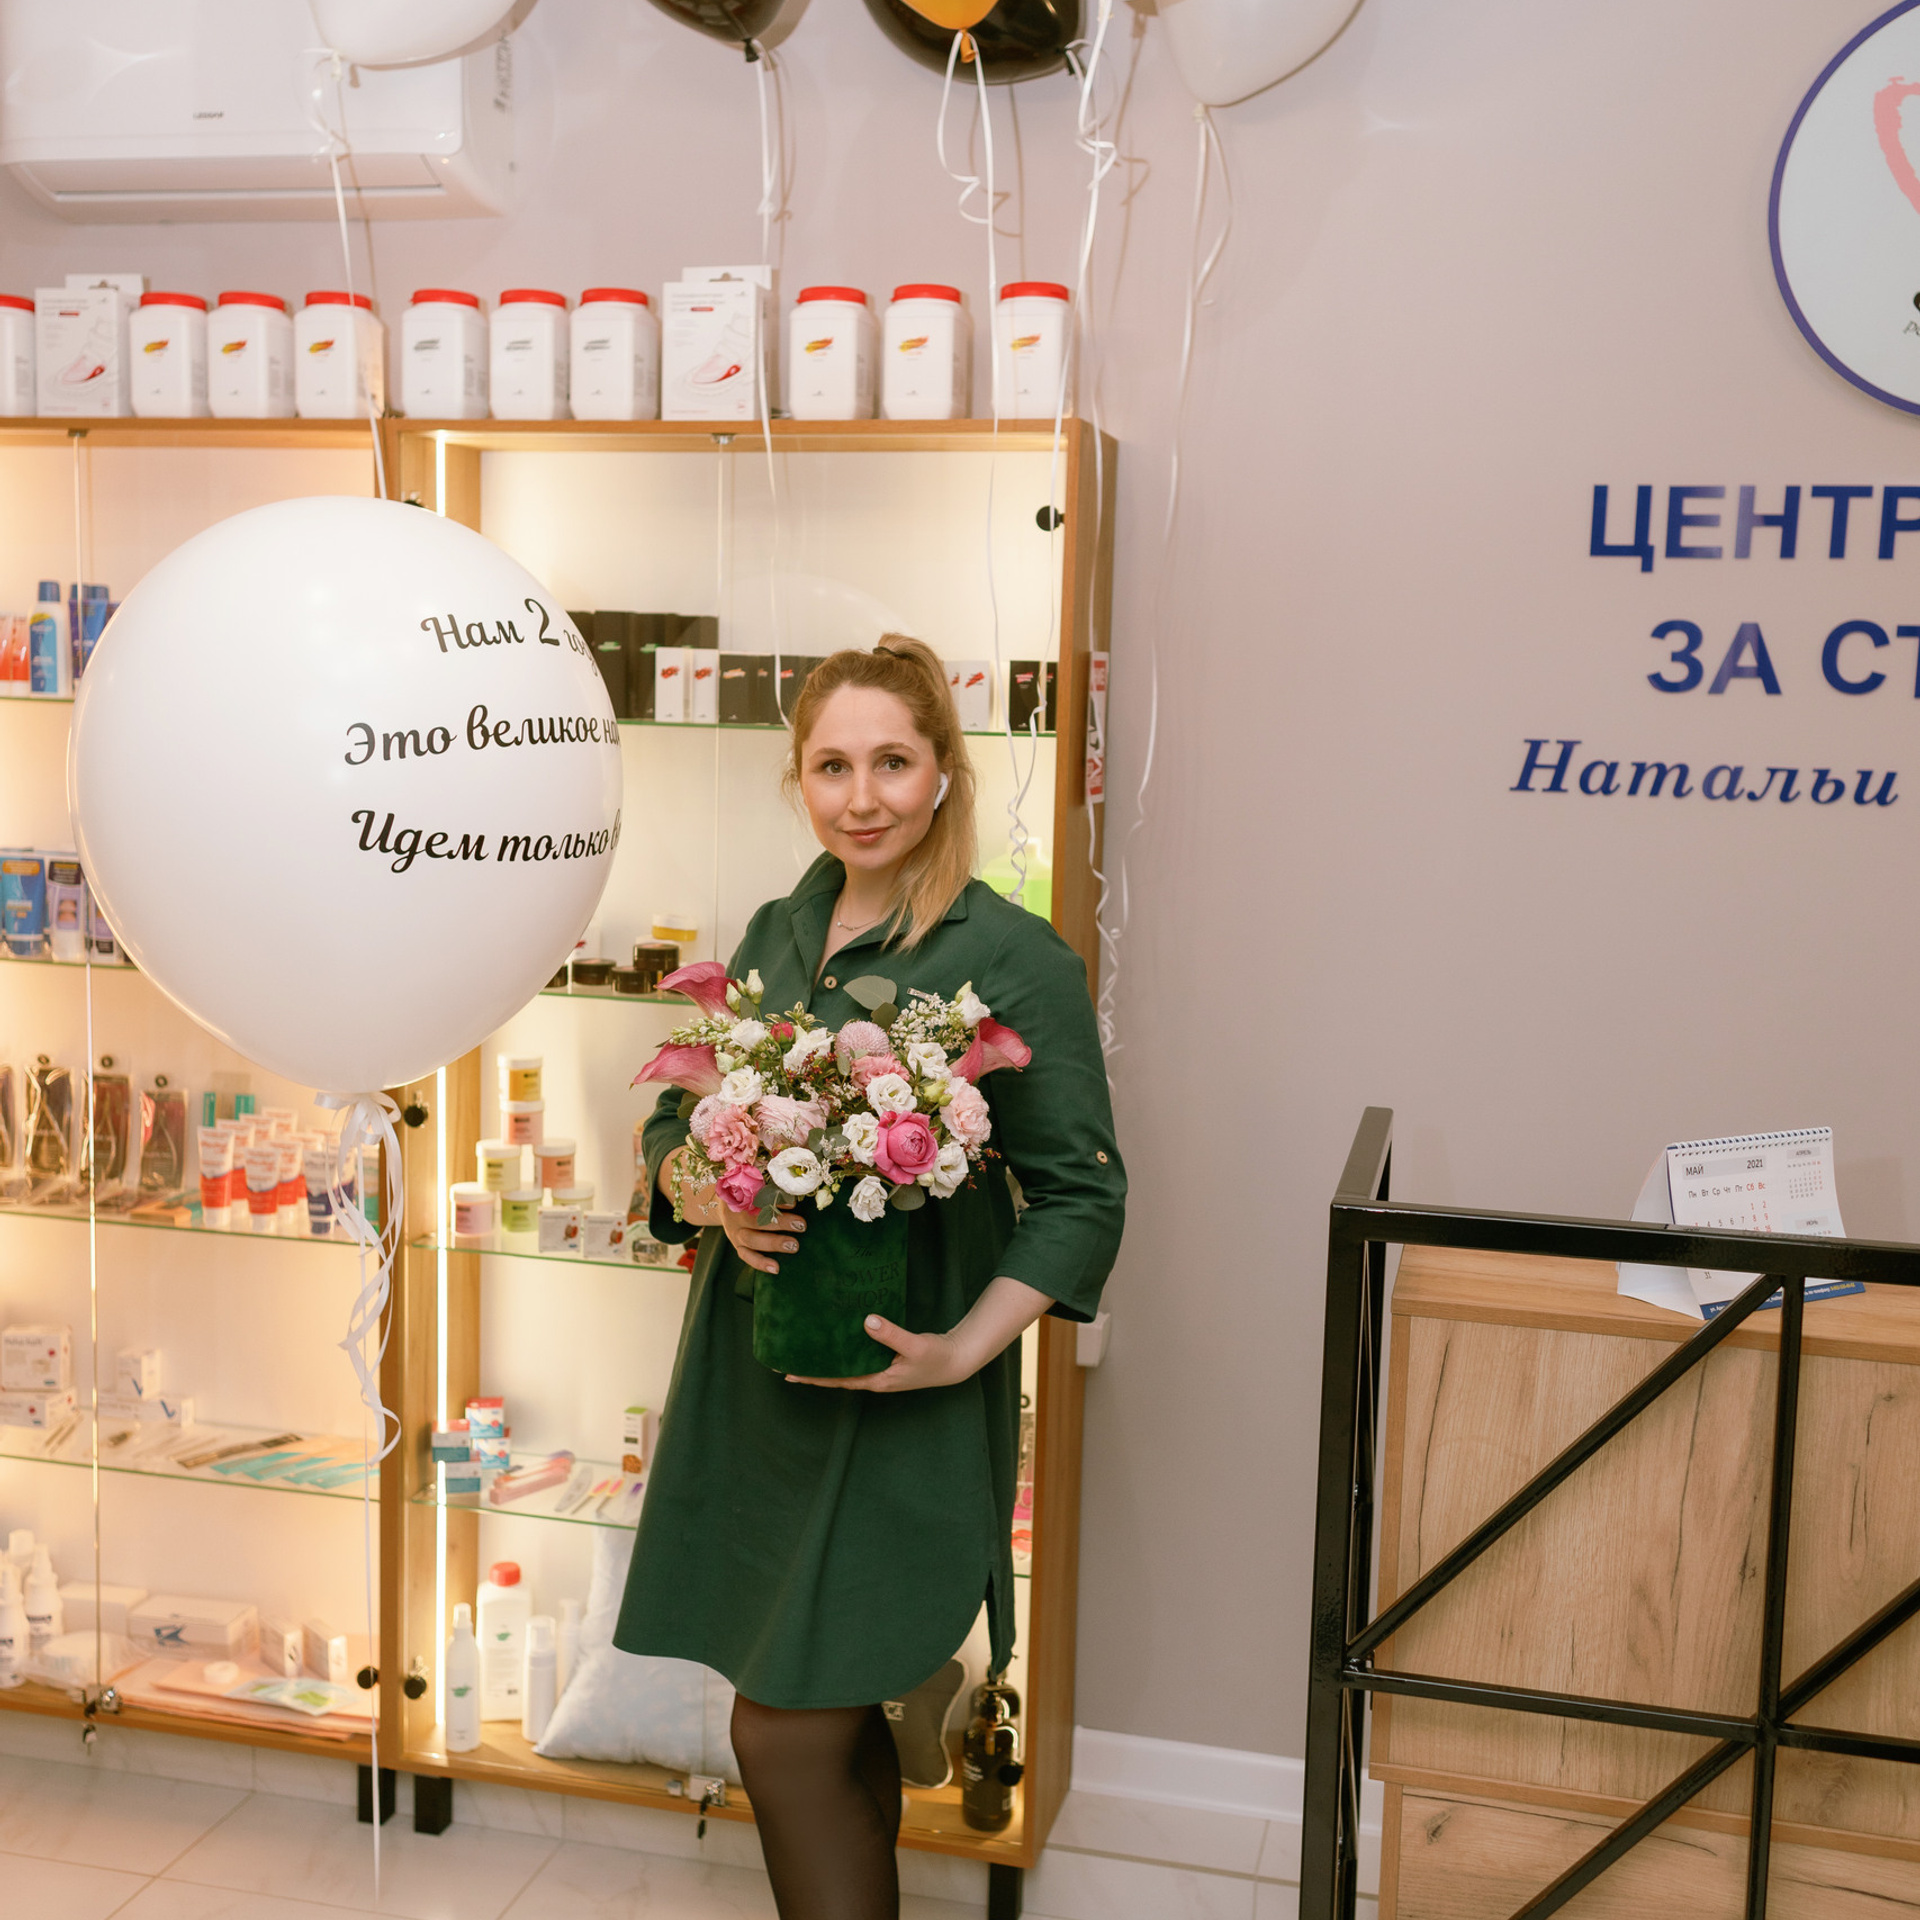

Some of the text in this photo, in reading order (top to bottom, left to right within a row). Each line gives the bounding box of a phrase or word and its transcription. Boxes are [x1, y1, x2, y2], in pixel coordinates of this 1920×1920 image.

[1589, 484, 1920, 573] ЦЕНТР
[420, 614, 525, 653] Нам
[524, 598, 560, 646] 2
[1646, 619, 1782, 696] ЗА
[344, 722, 457, 765] Это
[466, 704, 602, 751] великое
[1508, 738, 1899, 807] Натальи
[351, 809, 489, 873] Идем
[497, 828, 609, 862] только
[1685, 1159, 1763, 1176] МАЙ 2021
[1688, 1190, 1697, 1198] Пн
[1701, 1188, 1709, 1197] Вт
[1712, 1187, 1720, 1196] Ср
[1735, 1184, 1742, 1192] Пт
[1746, 1182, 1754, 1191] Сб
[1758, 1181, 1766, 1190] Вс
